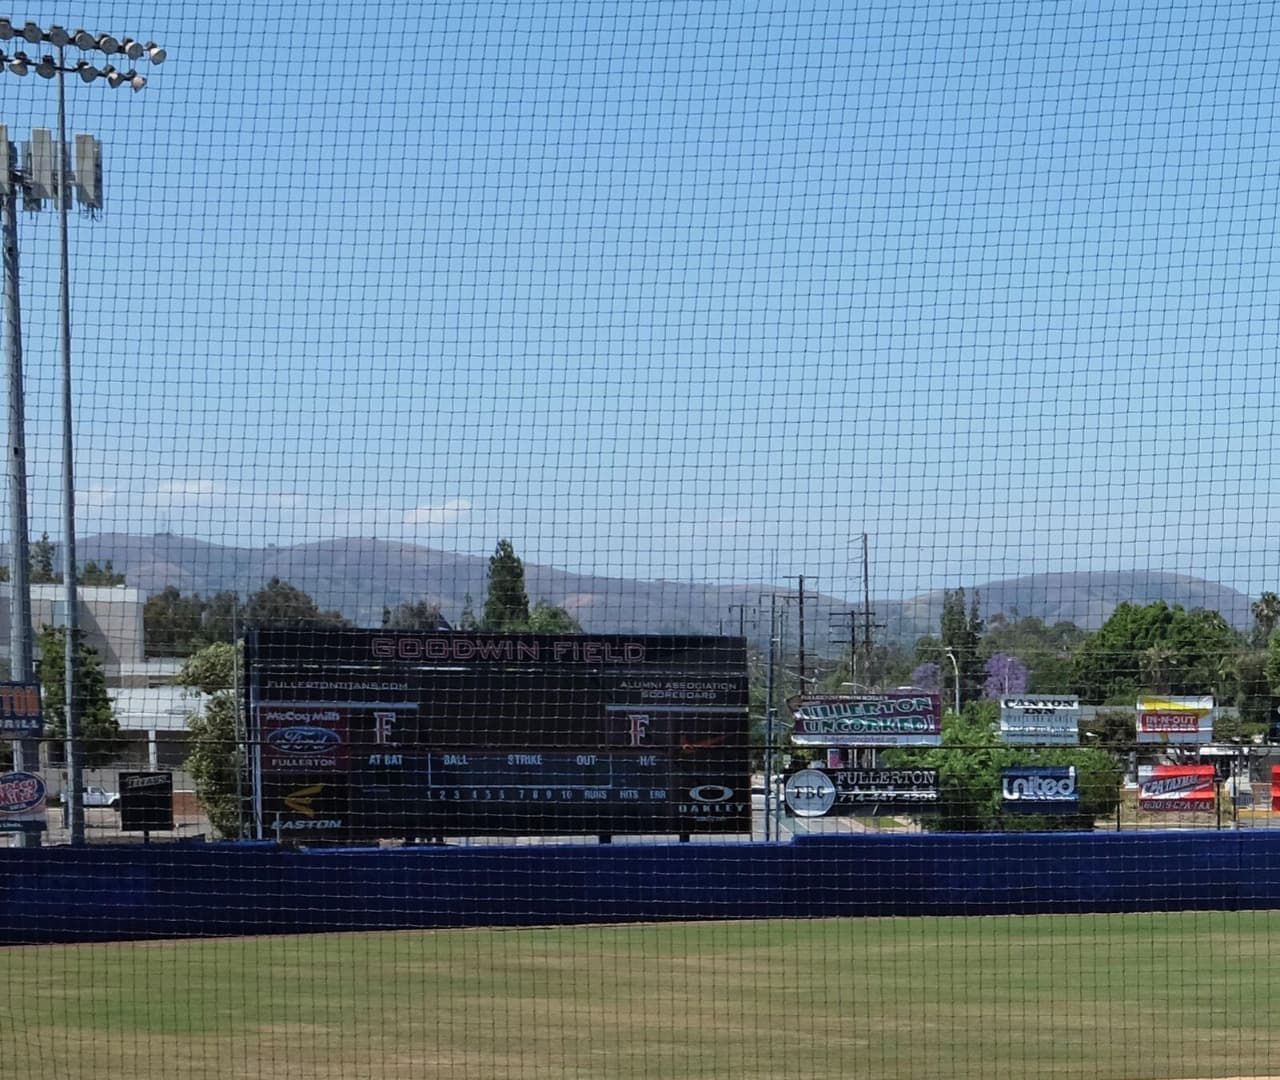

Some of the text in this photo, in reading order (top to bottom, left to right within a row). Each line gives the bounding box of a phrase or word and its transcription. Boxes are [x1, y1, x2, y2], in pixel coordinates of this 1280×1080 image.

[371, 638, 646, 662] GOODWIN FIELD
[264, 680, 409, 690] FULLERTONTITANS.COM
[620, 681, 737, 690] ALUMNI ASSOCIATION
[641, 690, 716, 699] SCOREBOARD
[1004, 699, 1075, 709] CANYON
[266, 711, 311, 722] McCoy
[1146, 716, 1196, 724] IN-N-OUT
[374, 711, 396, 746] F
[803, 715, 936, 734] UNCORKED!
[628, 714, 650, 748] F
[271, 759, 337, 767] FULLERTON
[369, 755, 403, 766] AT BAT
[443, 755, 469, 766] BALL
[507, 755, 543, 766] STRIKE
[576, 755, 597, 766] OUT
[836, 771, 936, 785] FULLERTON
[678, 804, 744, 813] OAKLEY
[271, 820, 342, 830] EASTON
